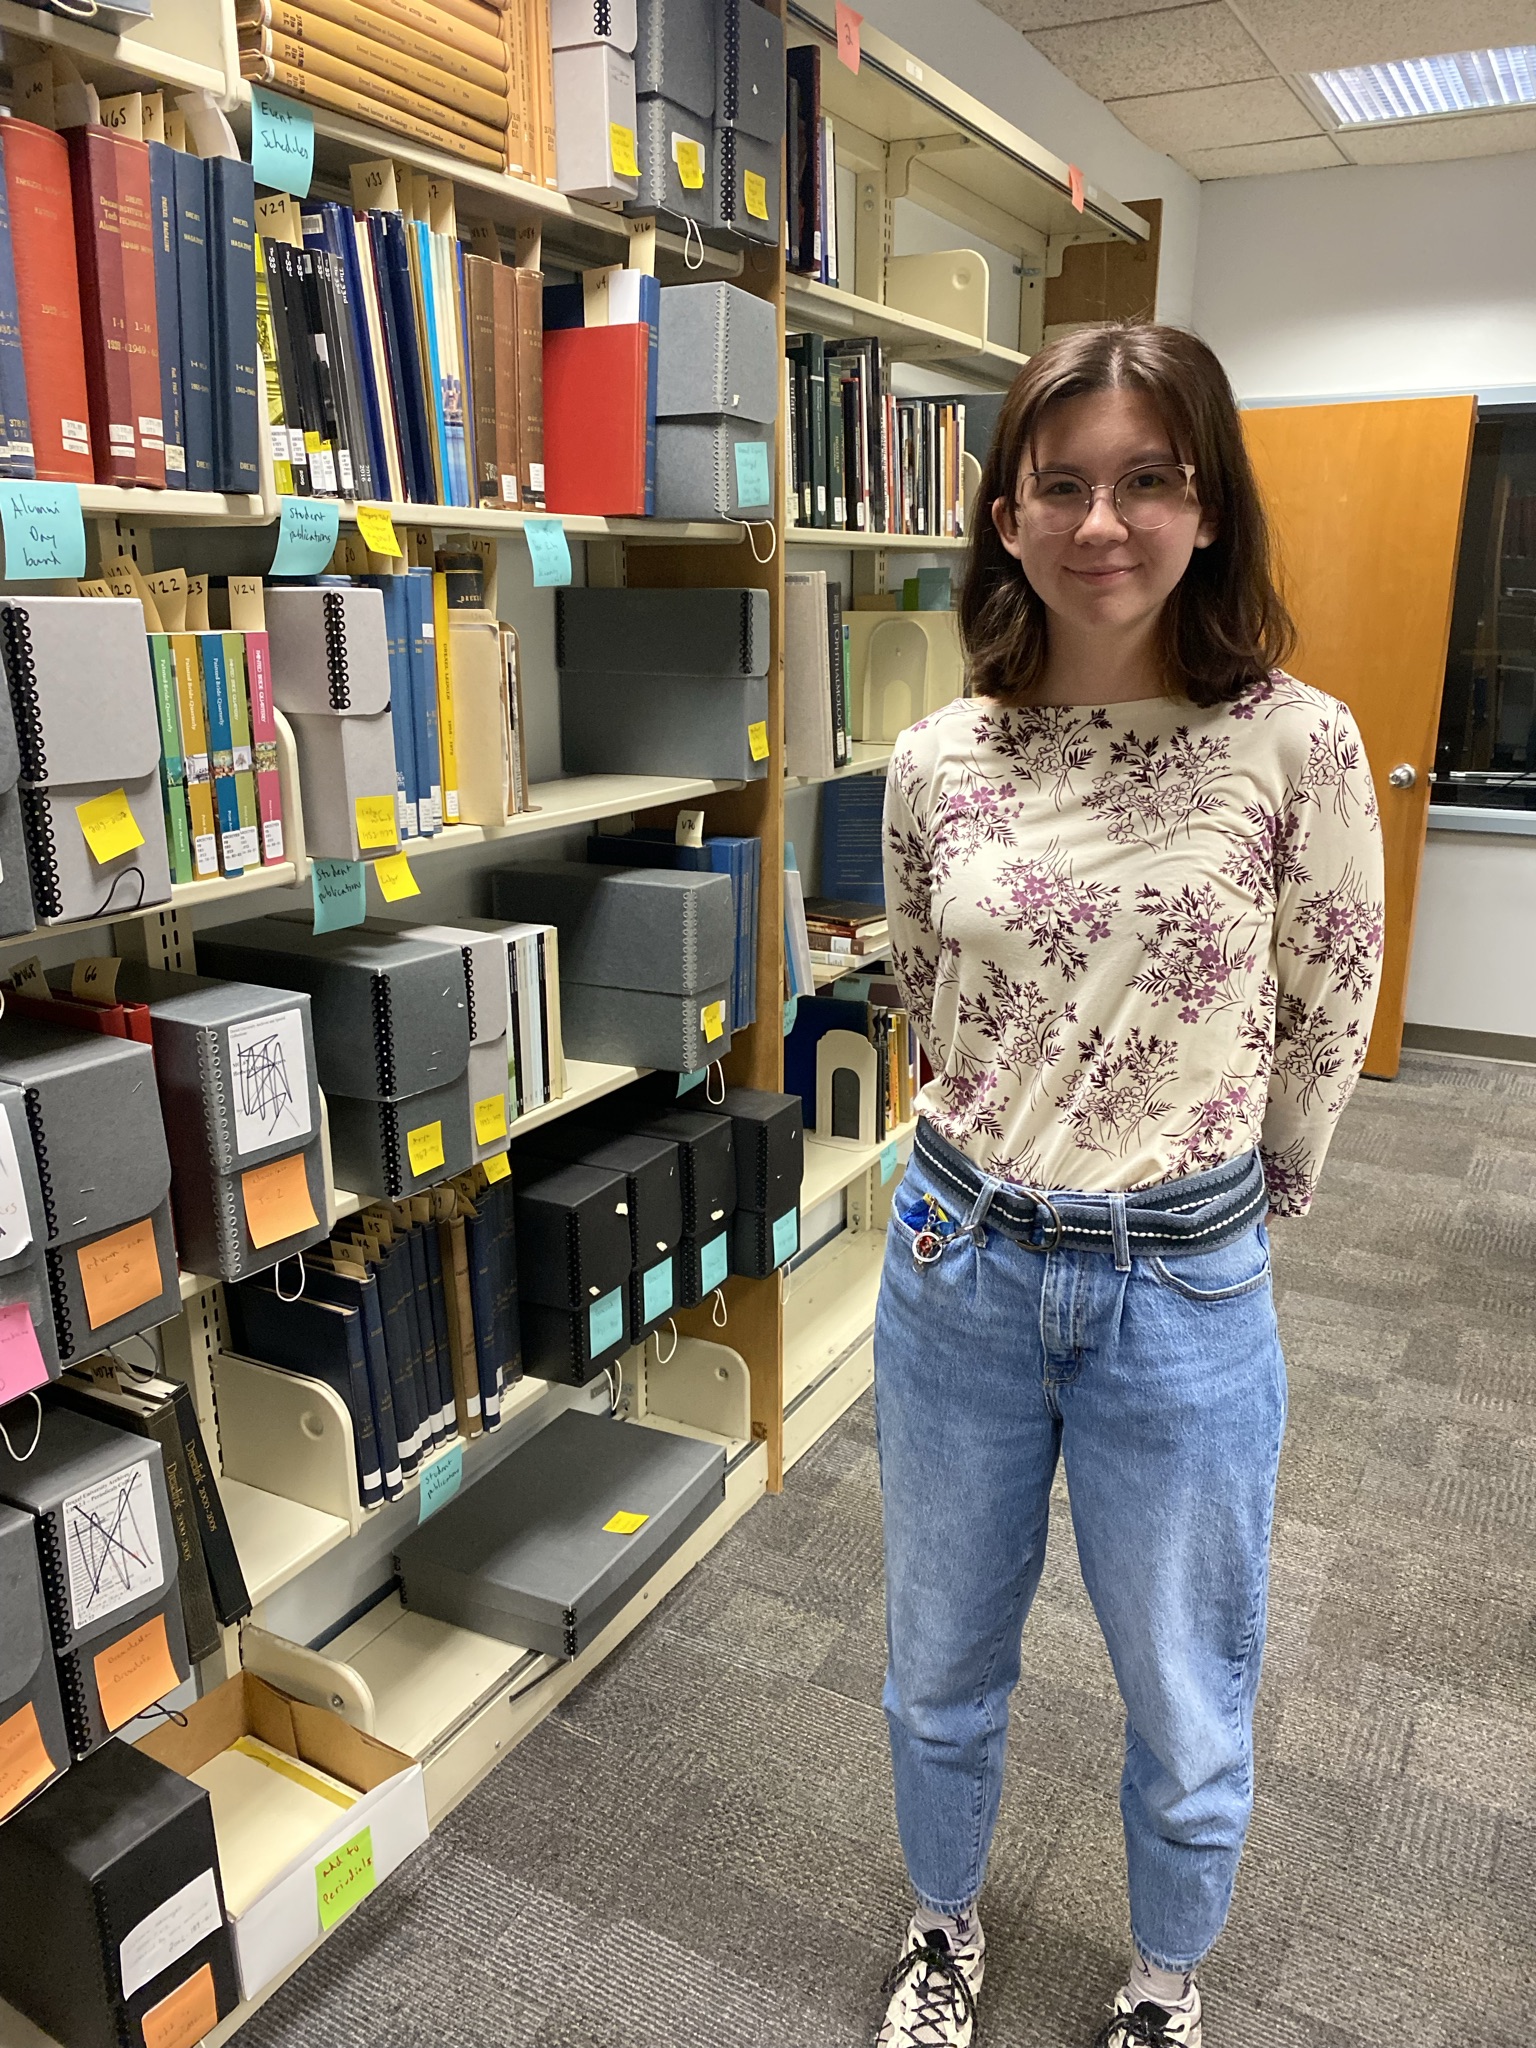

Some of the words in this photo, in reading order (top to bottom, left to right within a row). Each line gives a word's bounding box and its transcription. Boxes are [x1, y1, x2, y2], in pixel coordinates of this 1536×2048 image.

[261, 102, 293, 125] Event
[260, 200, 285, 217] V29
[12, 494, 60, 519] Alumni
[290, 506, 326, 522] Student
[289, 524, 331, 544] publications
[148, 578, 181, 594] V22
[234, 584, 256, 595] V24
[316, 864, 352, 882] Student
